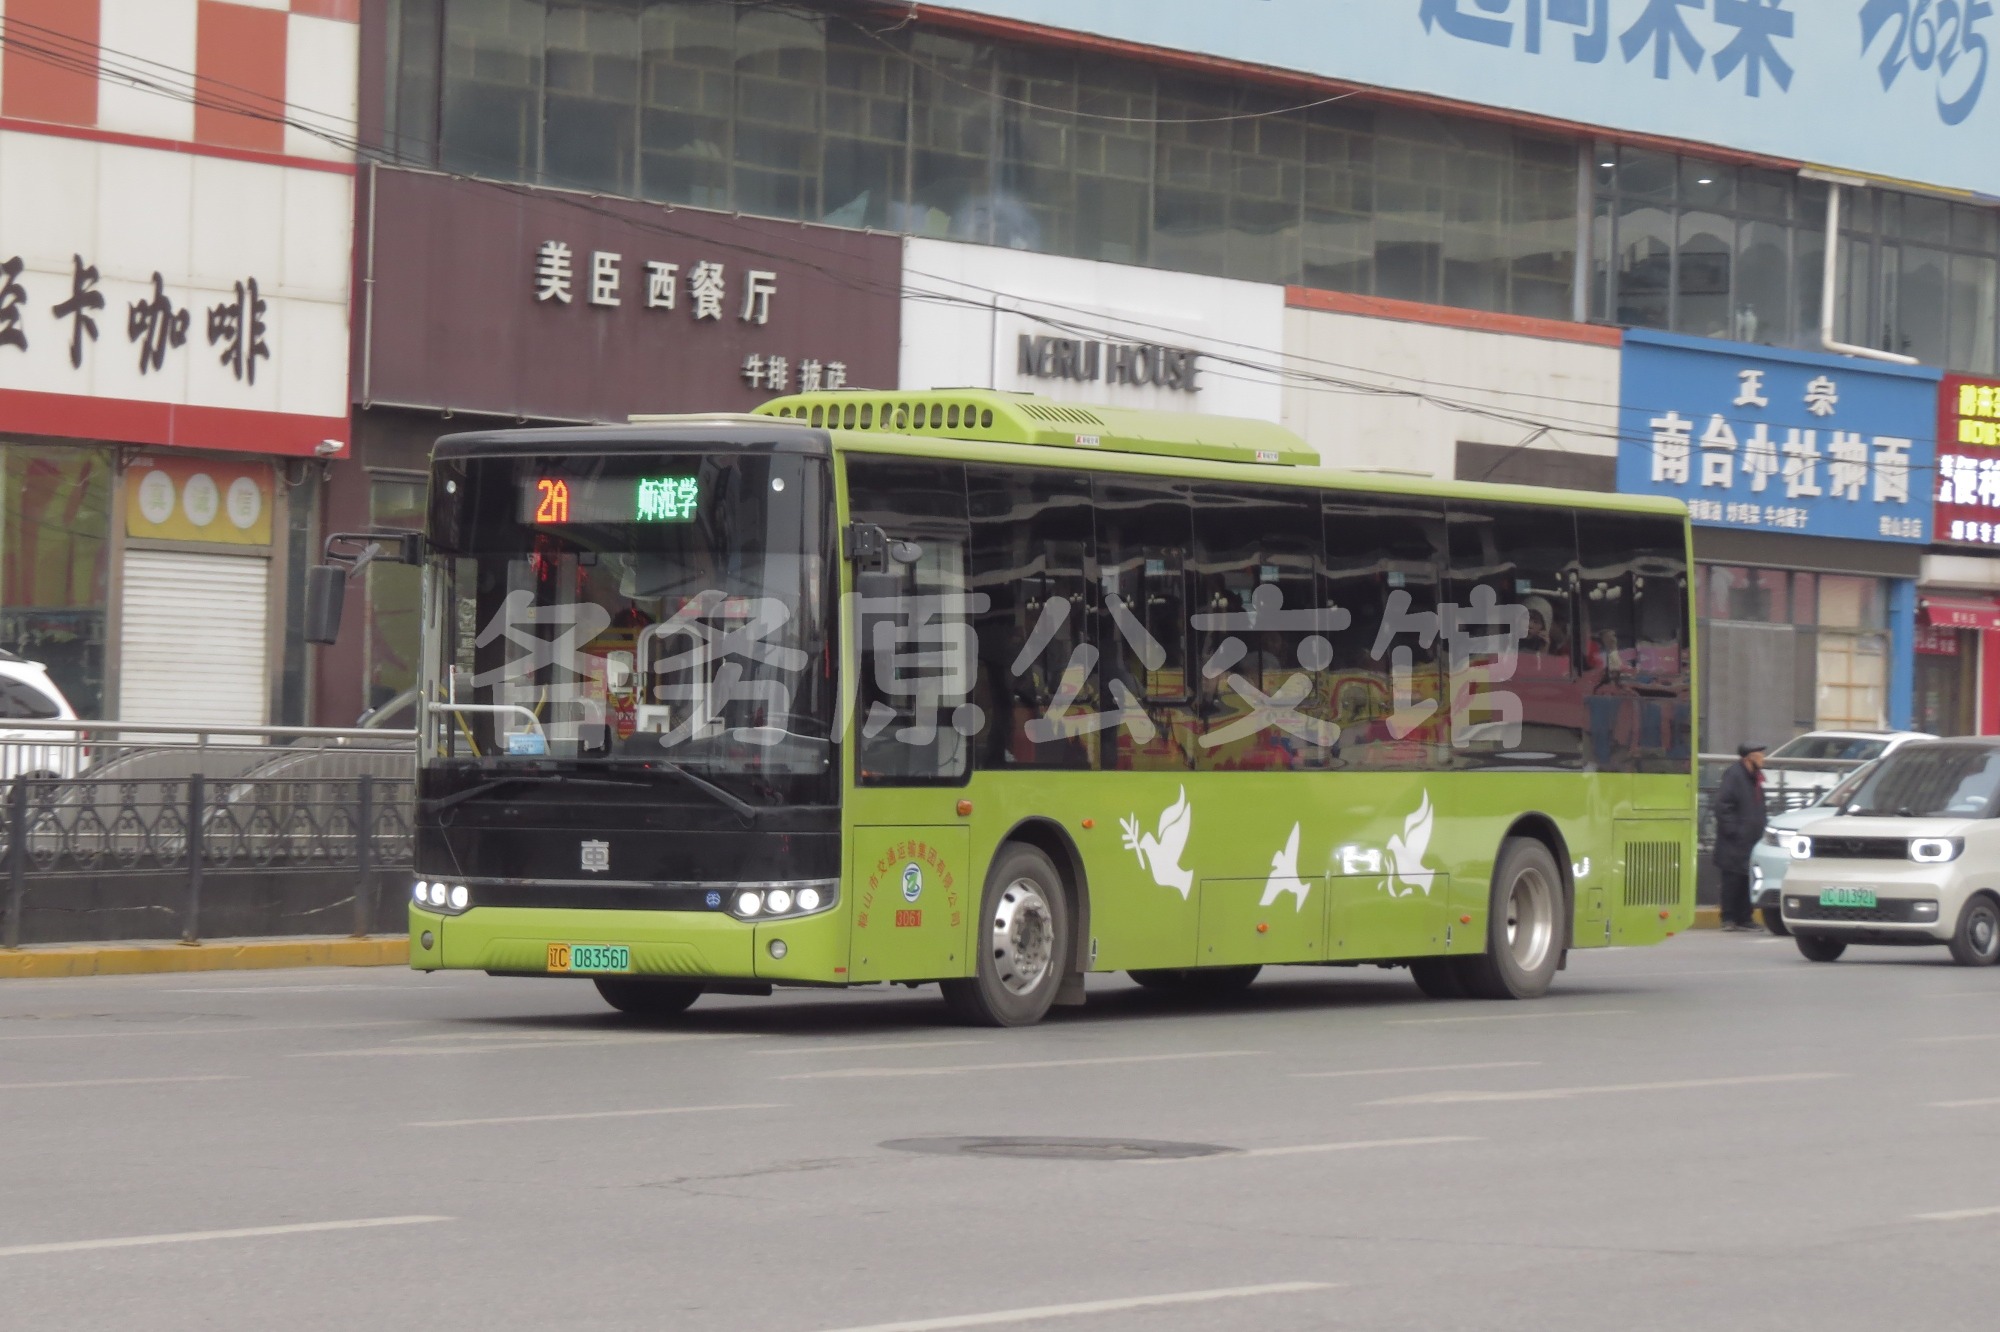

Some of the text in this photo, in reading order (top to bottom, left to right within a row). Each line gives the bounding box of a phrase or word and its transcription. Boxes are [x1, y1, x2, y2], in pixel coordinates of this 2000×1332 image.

[1858, 0, 1994, 126] 2025
[535, 240, 777, 325] 美臣西餐厅
[742, 353, 847, 392] 牛排 披萨
[1106, 343, 1203, 393] HOUSE
[1733, 369, 1839, 417] 正宗
[1650, 410, 1913, 504] 南台小杜抻面
[536, 478, 570, 524] 2A
[635, 475, 699, 522] 师范学
[896, 910, 922, 927] 3061
